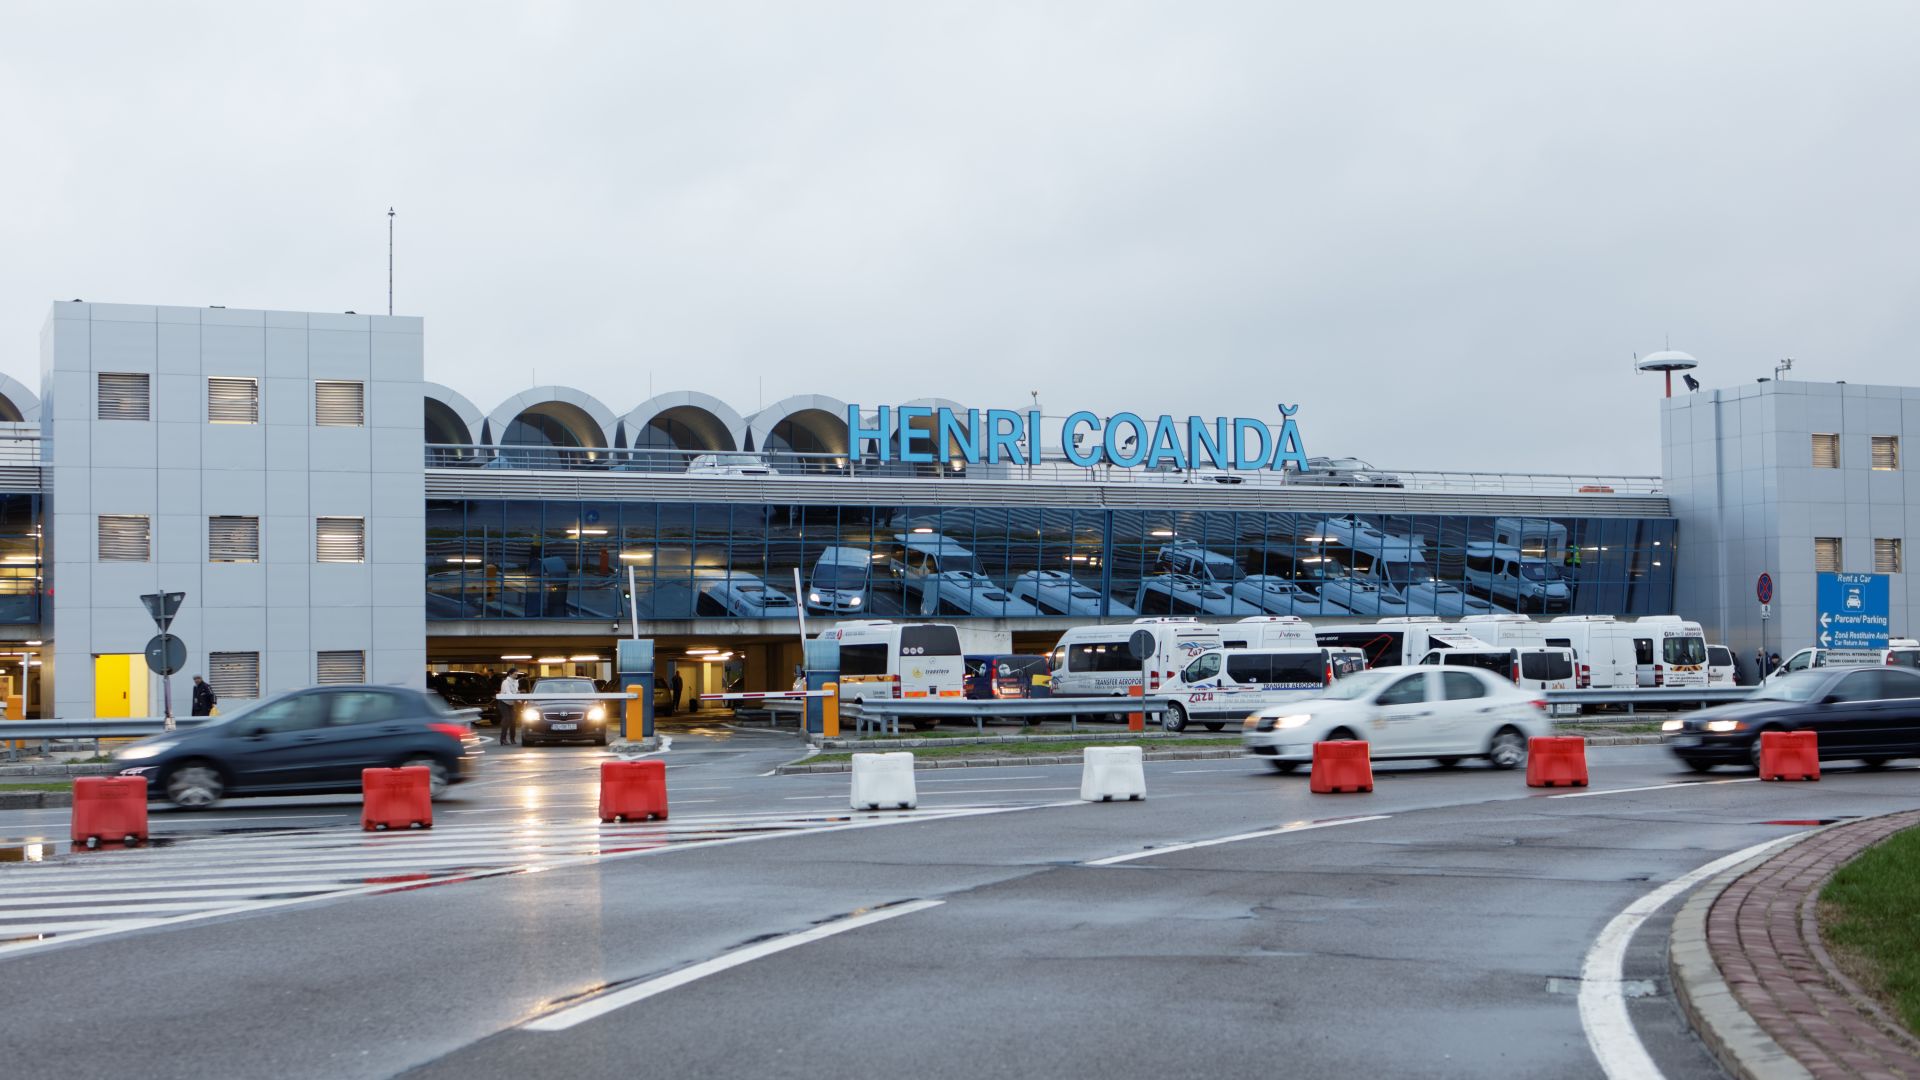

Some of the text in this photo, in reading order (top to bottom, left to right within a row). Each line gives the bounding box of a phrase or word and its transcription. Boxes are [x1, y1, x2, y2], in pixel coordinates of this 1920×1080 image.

[847, 403, 1310, 472] HENRI COANDĂ
[1837, 574, 1853, 583] Rent
[1860, 575, 1872, 583] Car
[1863, 615, 1887, 626] Parking
[1876, 632, 1889, 640] Auto
